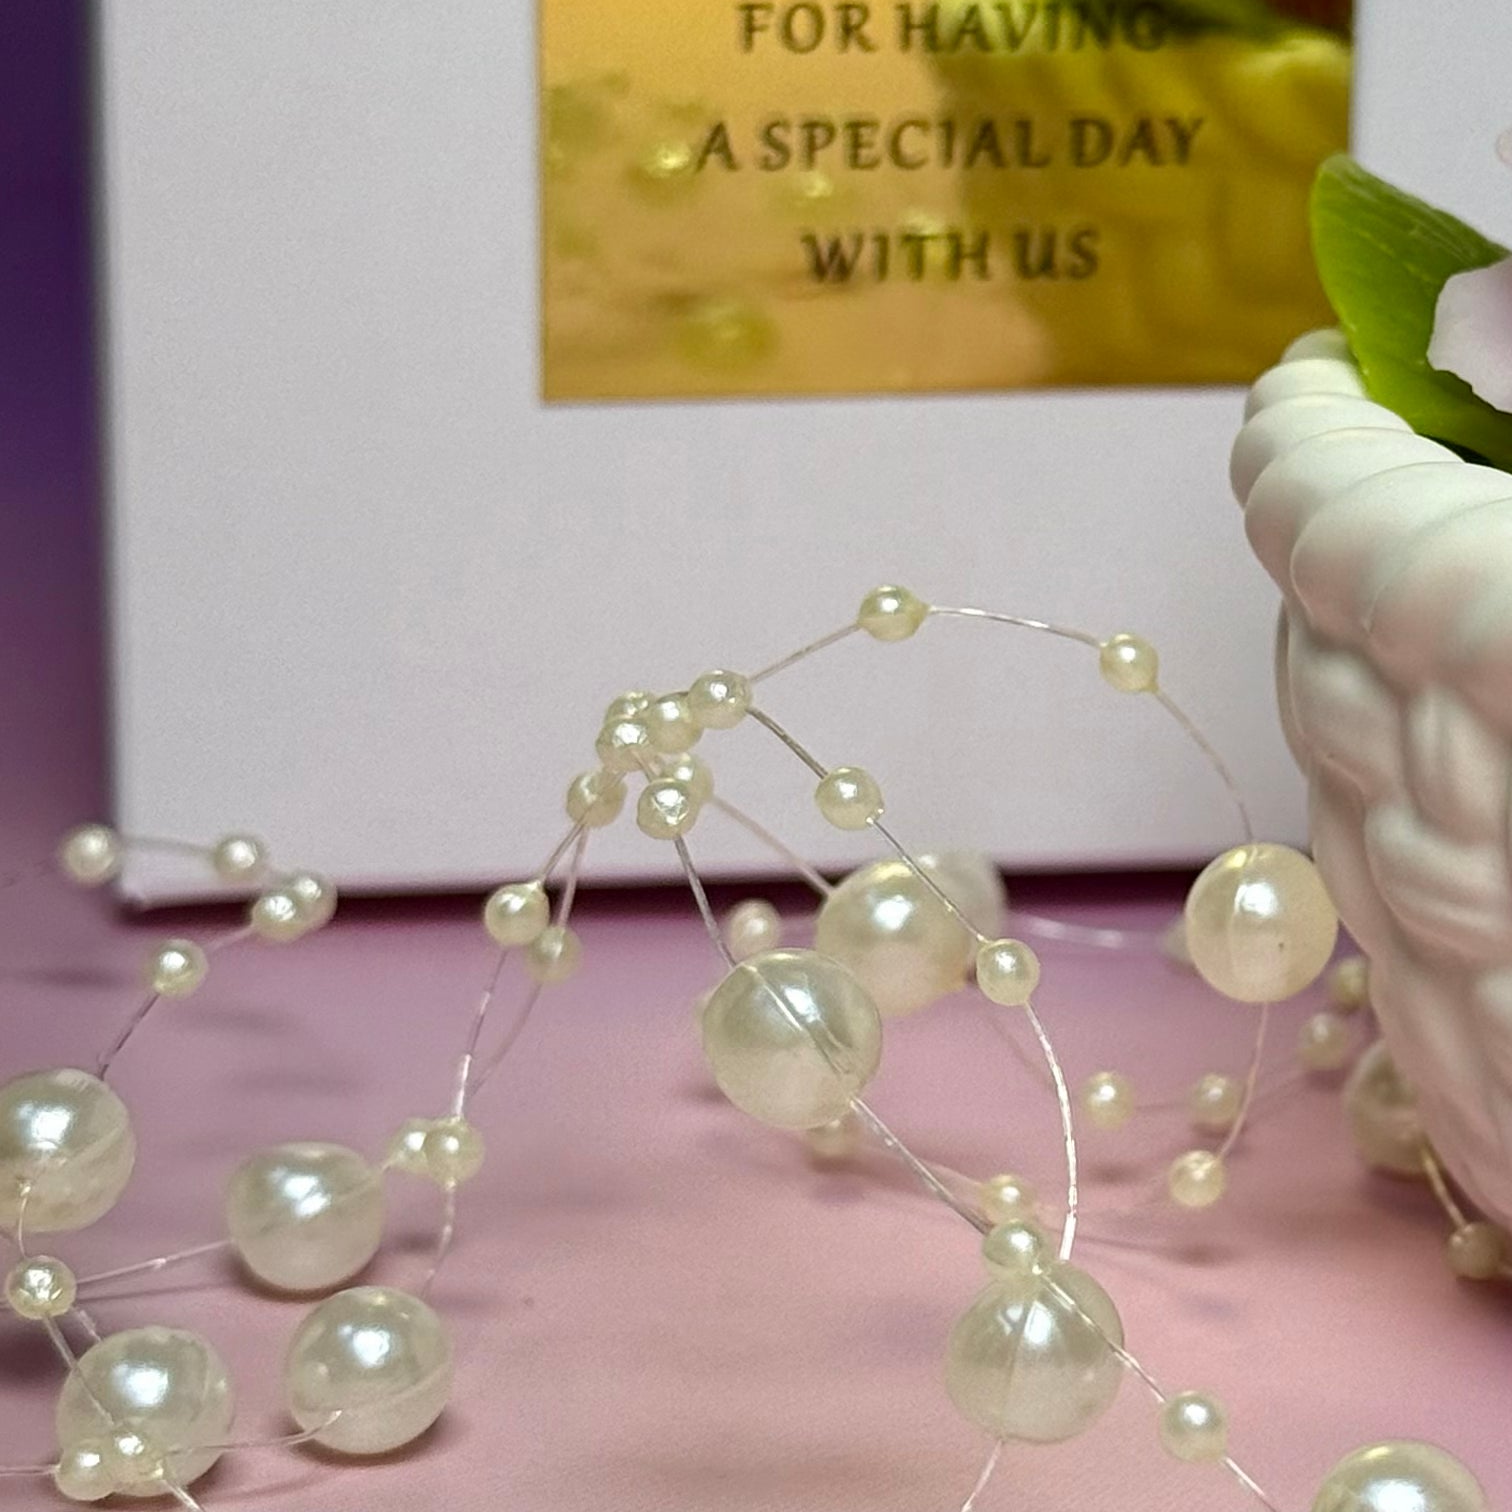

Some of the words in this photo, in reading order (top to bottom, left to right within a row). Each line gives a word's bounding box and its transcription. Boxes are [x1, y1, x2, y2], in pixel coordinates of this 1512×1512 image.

[736, 0, 876, 55] FOR
[695, 118, 738, 173] A
[759, 117, 1051, 172] SPECIAL
[1067, 115, 1204, 169] DAY
[801, 228, 991, 284] WITH
[1012, 227, 1100, 281] US
